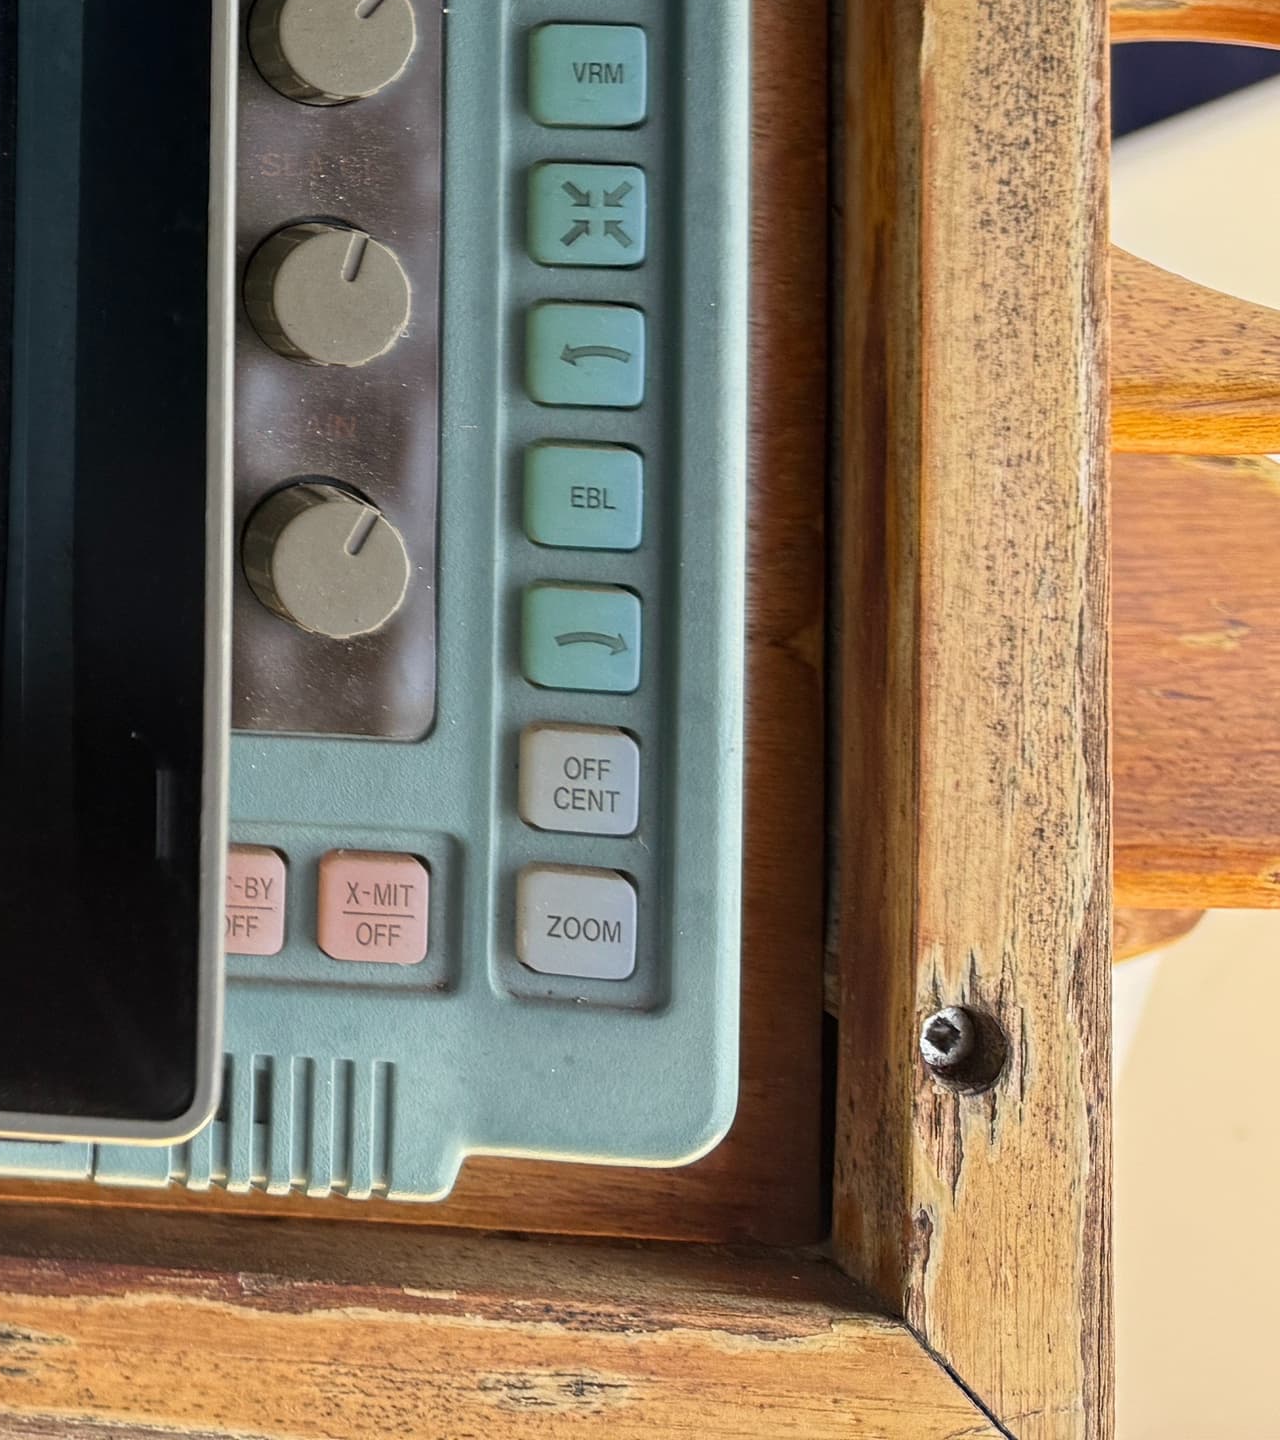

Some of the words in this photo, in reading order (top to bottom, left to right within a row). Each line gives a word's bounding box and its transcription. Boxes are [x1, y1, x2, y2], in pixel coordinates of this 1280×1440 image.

[571, 61, 624, 84] VRM
[570, 485, 617, 510] EBL
[563, 756, 611, 781] OFF
[553, 786, 621, 813] CENT
[345, 880, 415, 908] X-MIT
[355, 921, 402, 947] OFF
[546, 914, 622, 944] ZOOM
